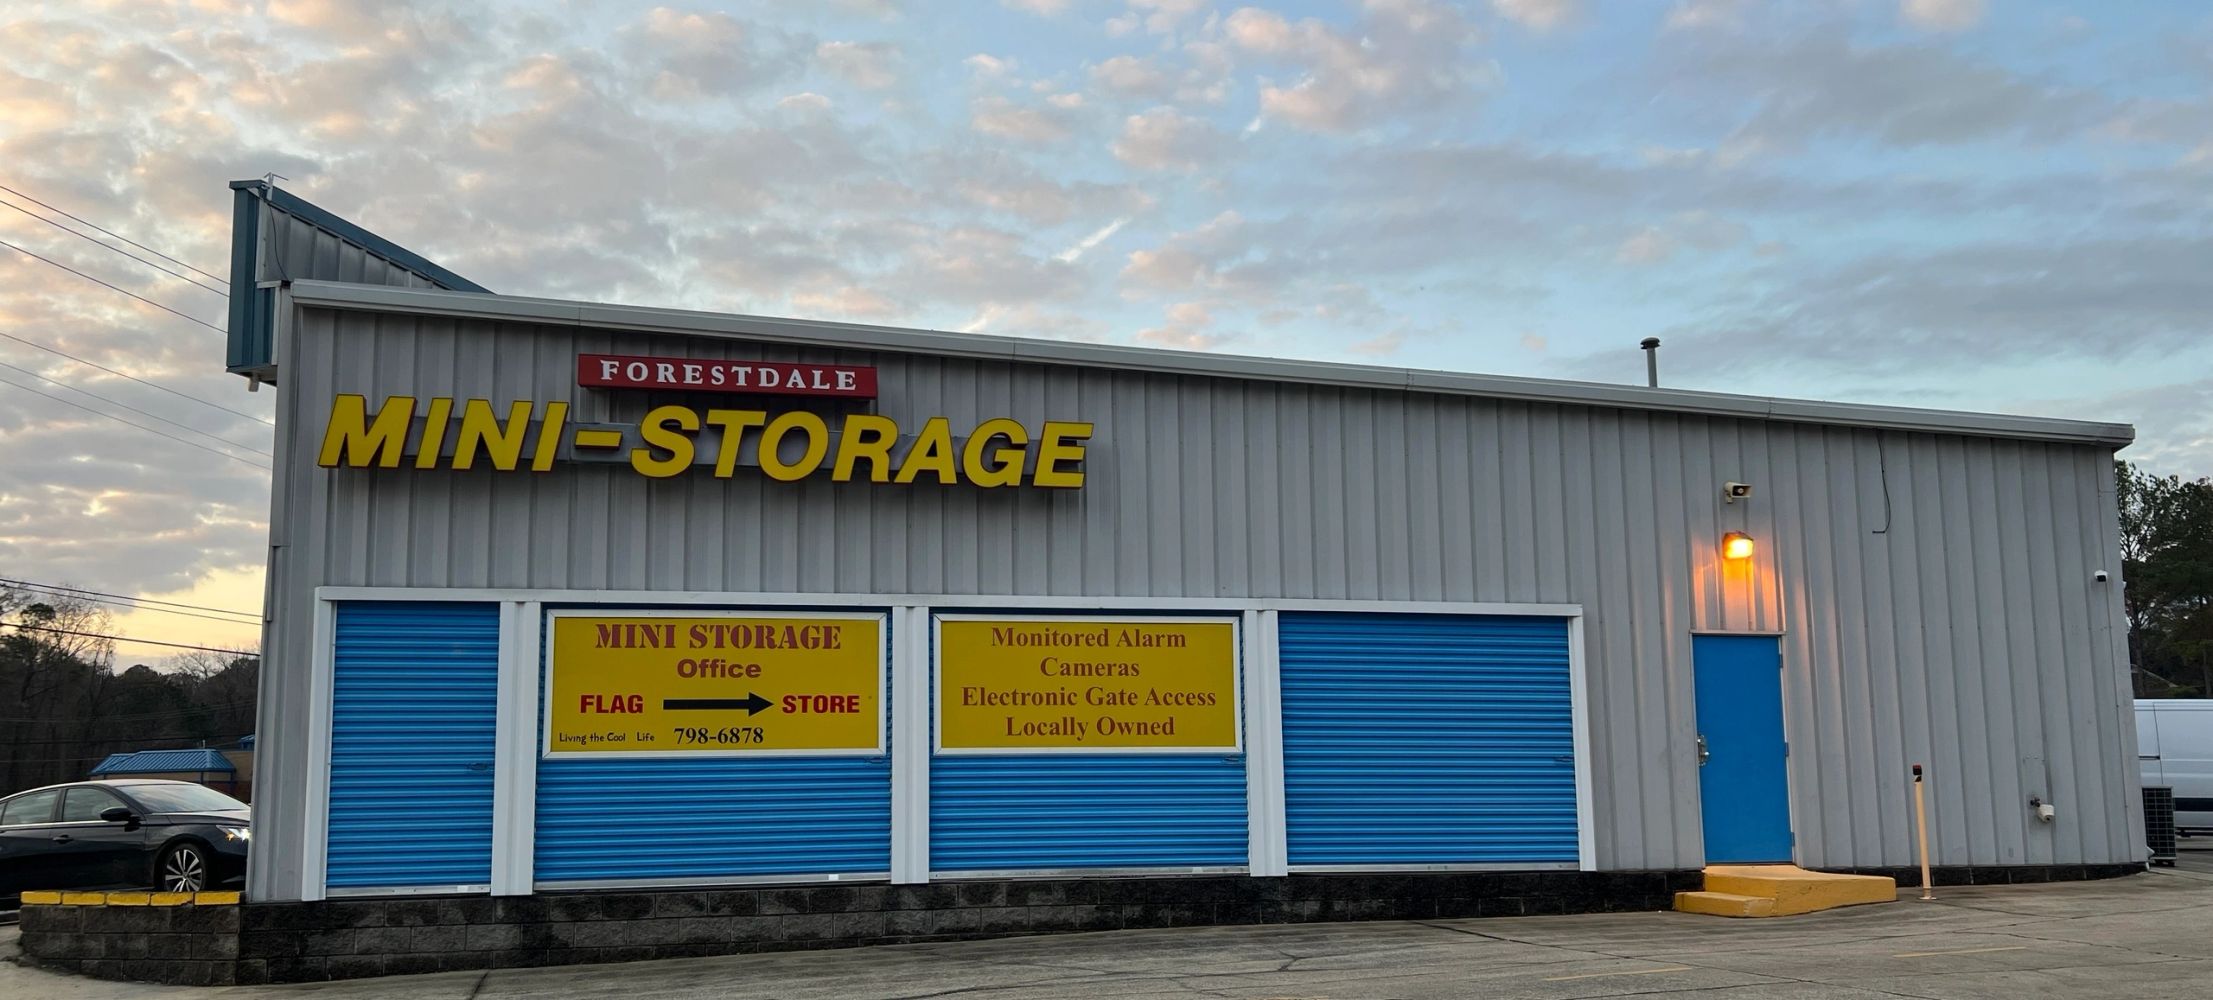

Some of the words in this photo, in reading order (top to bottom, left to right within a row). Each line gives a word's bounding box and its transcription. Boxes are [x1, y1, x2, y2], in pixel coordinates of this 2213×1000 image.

[600, 360, 858, 391] FORESTDALE
[318, 394, 1094, 490] MINI-STORAGE
[595, 623, 676, 649] MINI
[689, 624, 842, 650] STORAGE
[991, 627, 1110, 648] Monitored
[1116, 628, 1187, 648] Alarm
[677, 658, 762, 679] Office
[1040, 657, 1140, 677] Cameras
[580, 694, 644, 714] FLAG
[782, 695, 860, 713] STORE
[961, 686, 1078, 707] Electronic
[1085, 686, 1139, 707] Gate
[1145, 687, 1217, 707] Access
[559, 732, 587, 745] Living
[589, 732, 605, 742] the
[606, 732, 626, 742] Cool
[636, 732, 655, 742] Life
[673, 727, 764, 745] 798-6878
[1006, 716, 1089, 741] Locally
[1096, 716, 1176, 736] Owned
